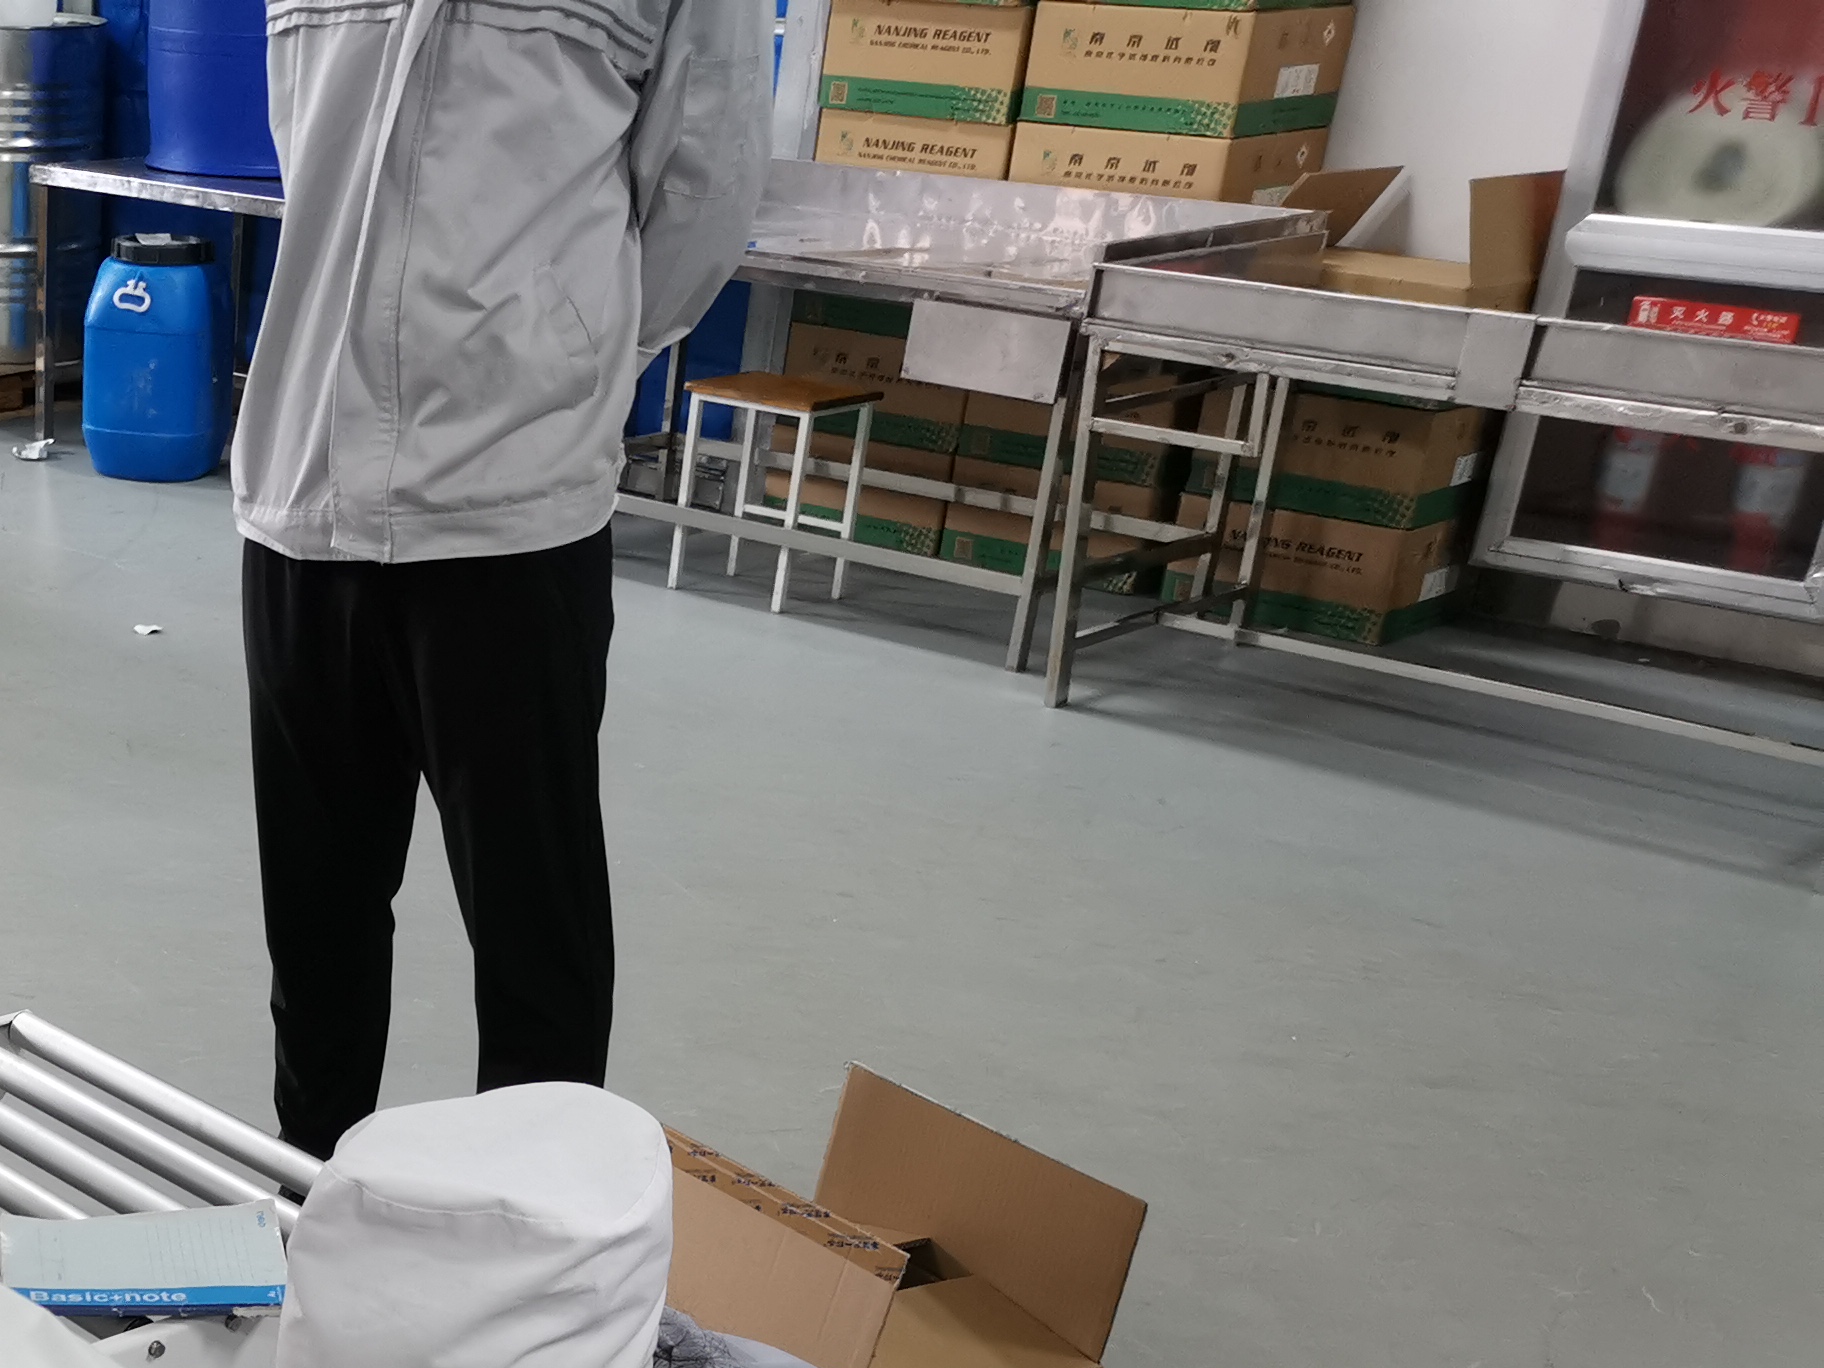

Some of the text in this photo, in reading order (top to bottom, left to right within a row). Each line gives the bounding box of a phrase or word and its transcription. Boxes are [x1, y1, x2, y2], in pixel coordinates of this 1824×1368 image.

[874, 24, 992, 43] NANJING REAGENT
[863, 137, 977, 159] NANJING REAGENT
[29, 1289, 187, 1303] Basic+note
